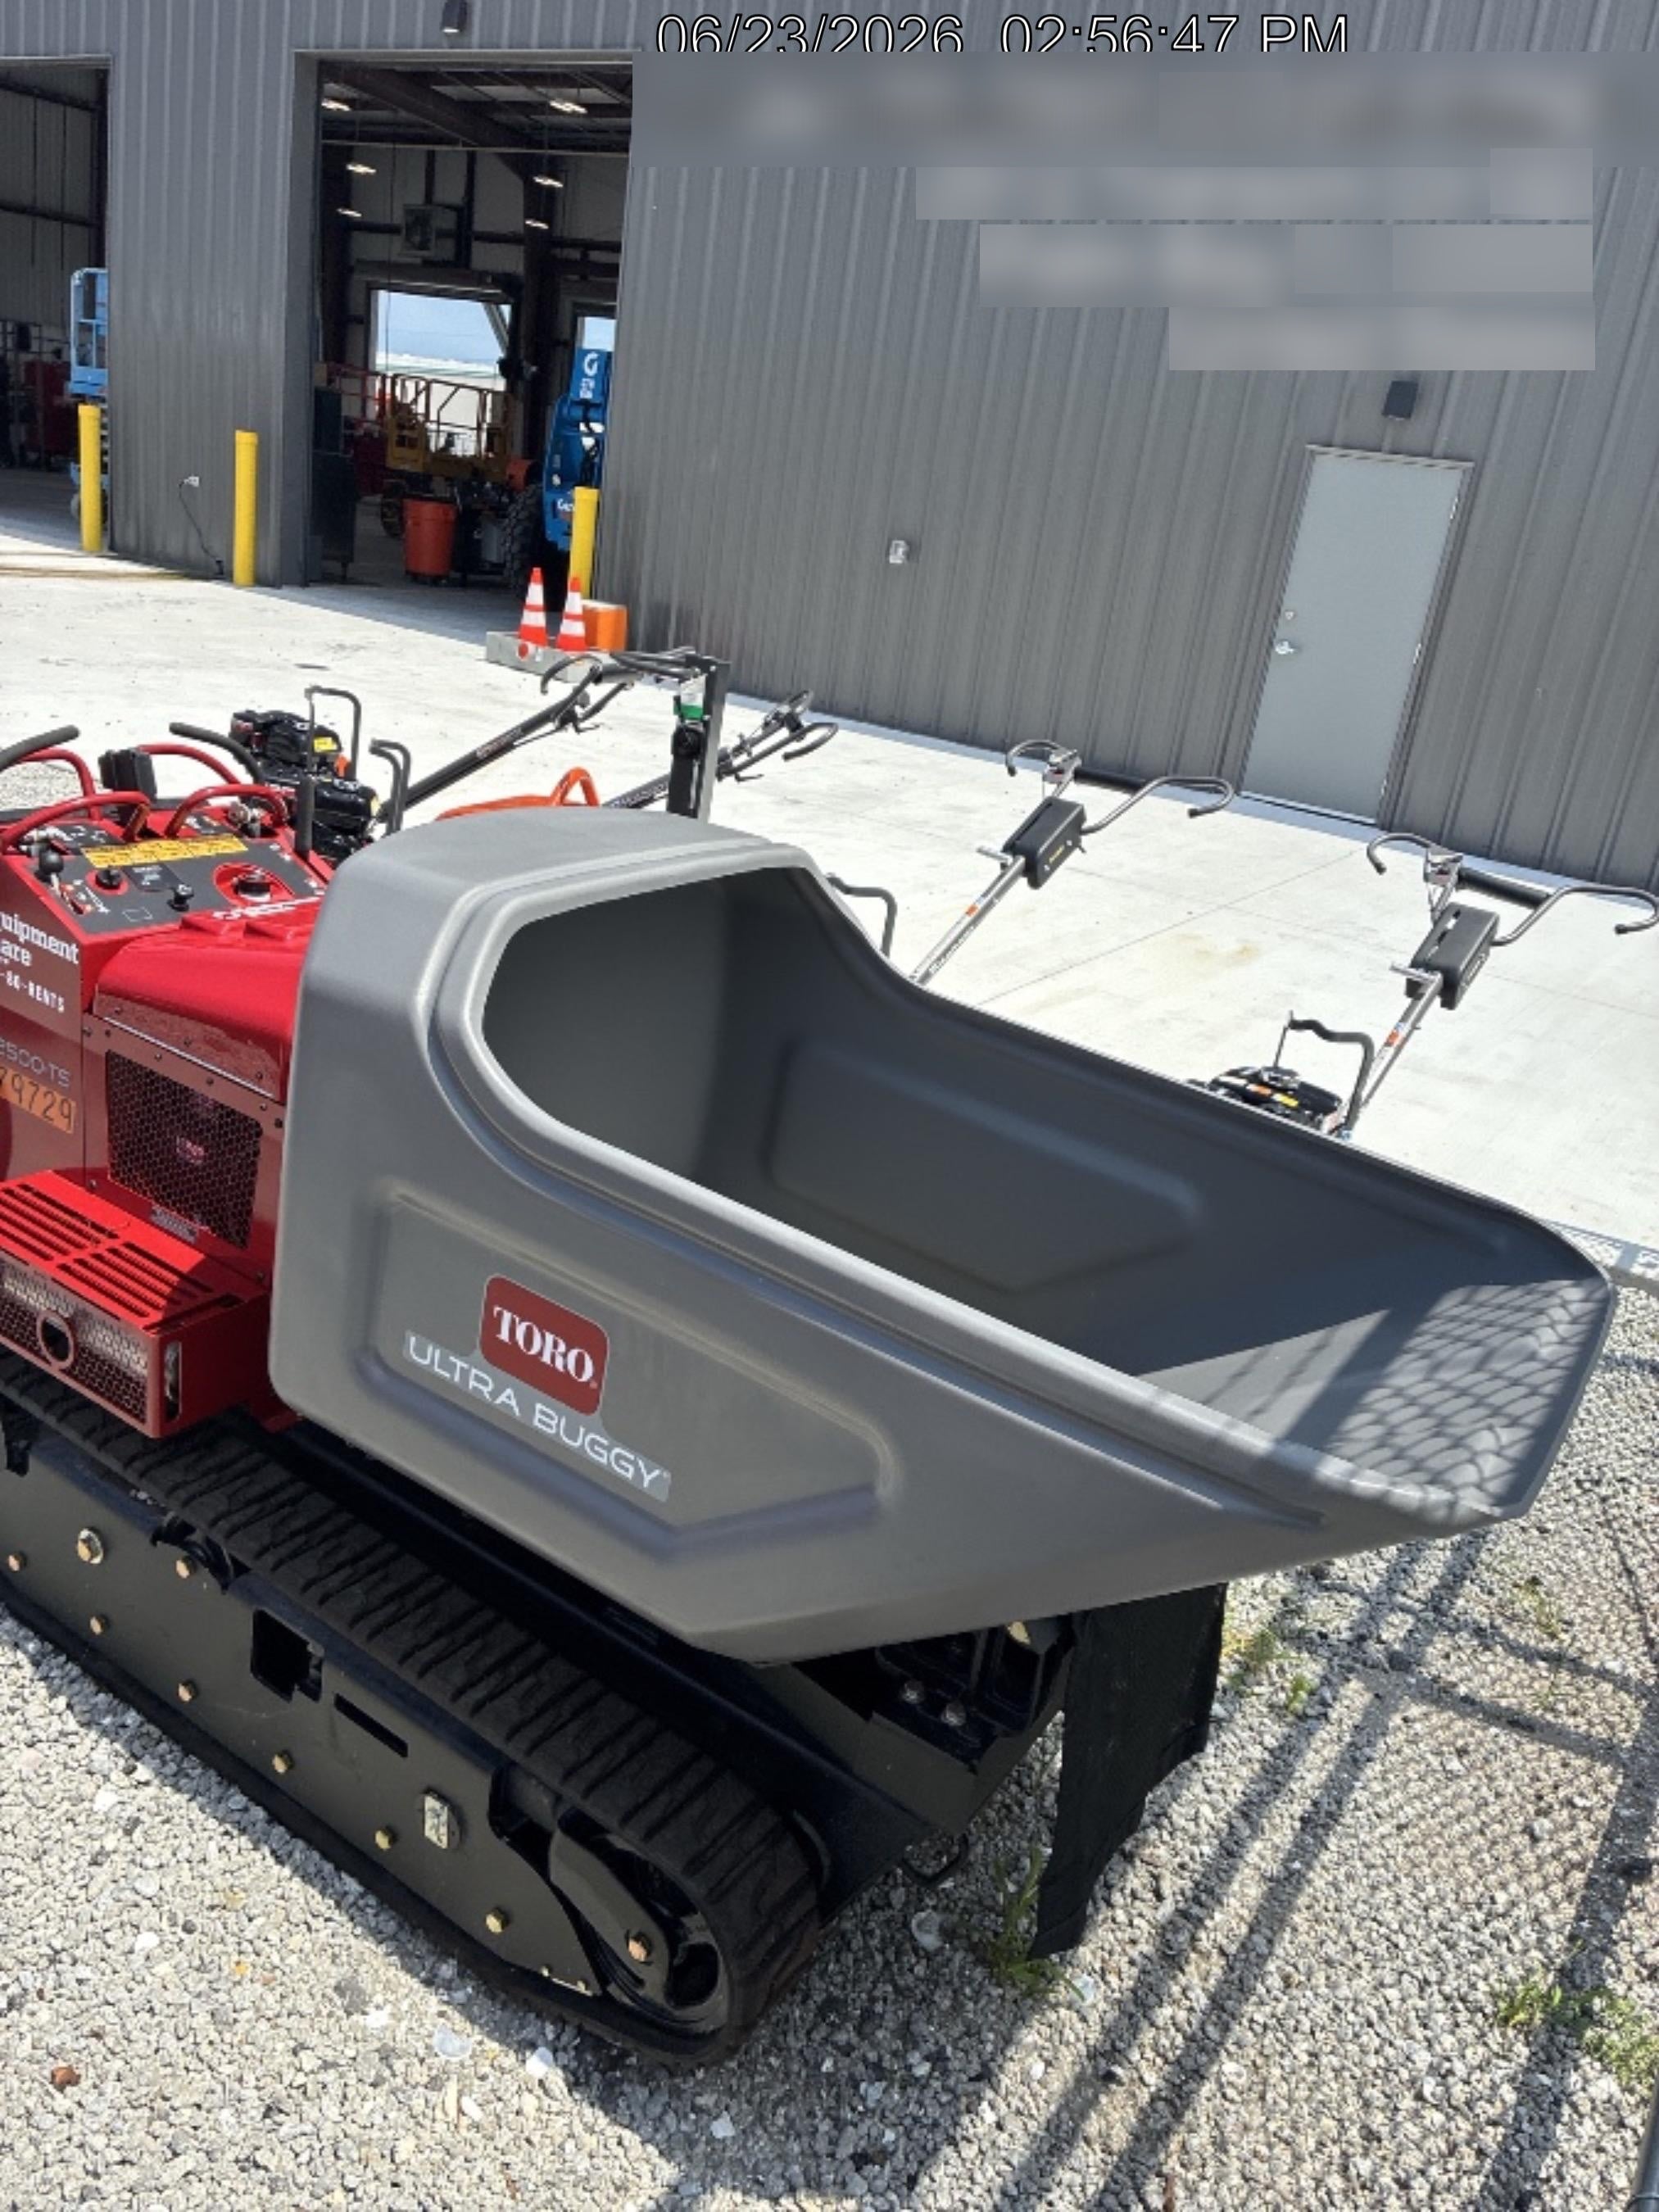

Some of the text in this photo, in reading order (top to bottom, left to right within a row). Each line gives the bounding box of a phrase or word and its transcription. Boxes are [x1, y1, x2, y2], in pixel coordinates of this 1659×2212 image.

[493, 1304, 595, 1383] TORO
[410, 1335, 662, 1489] ULTRA BUGGY
